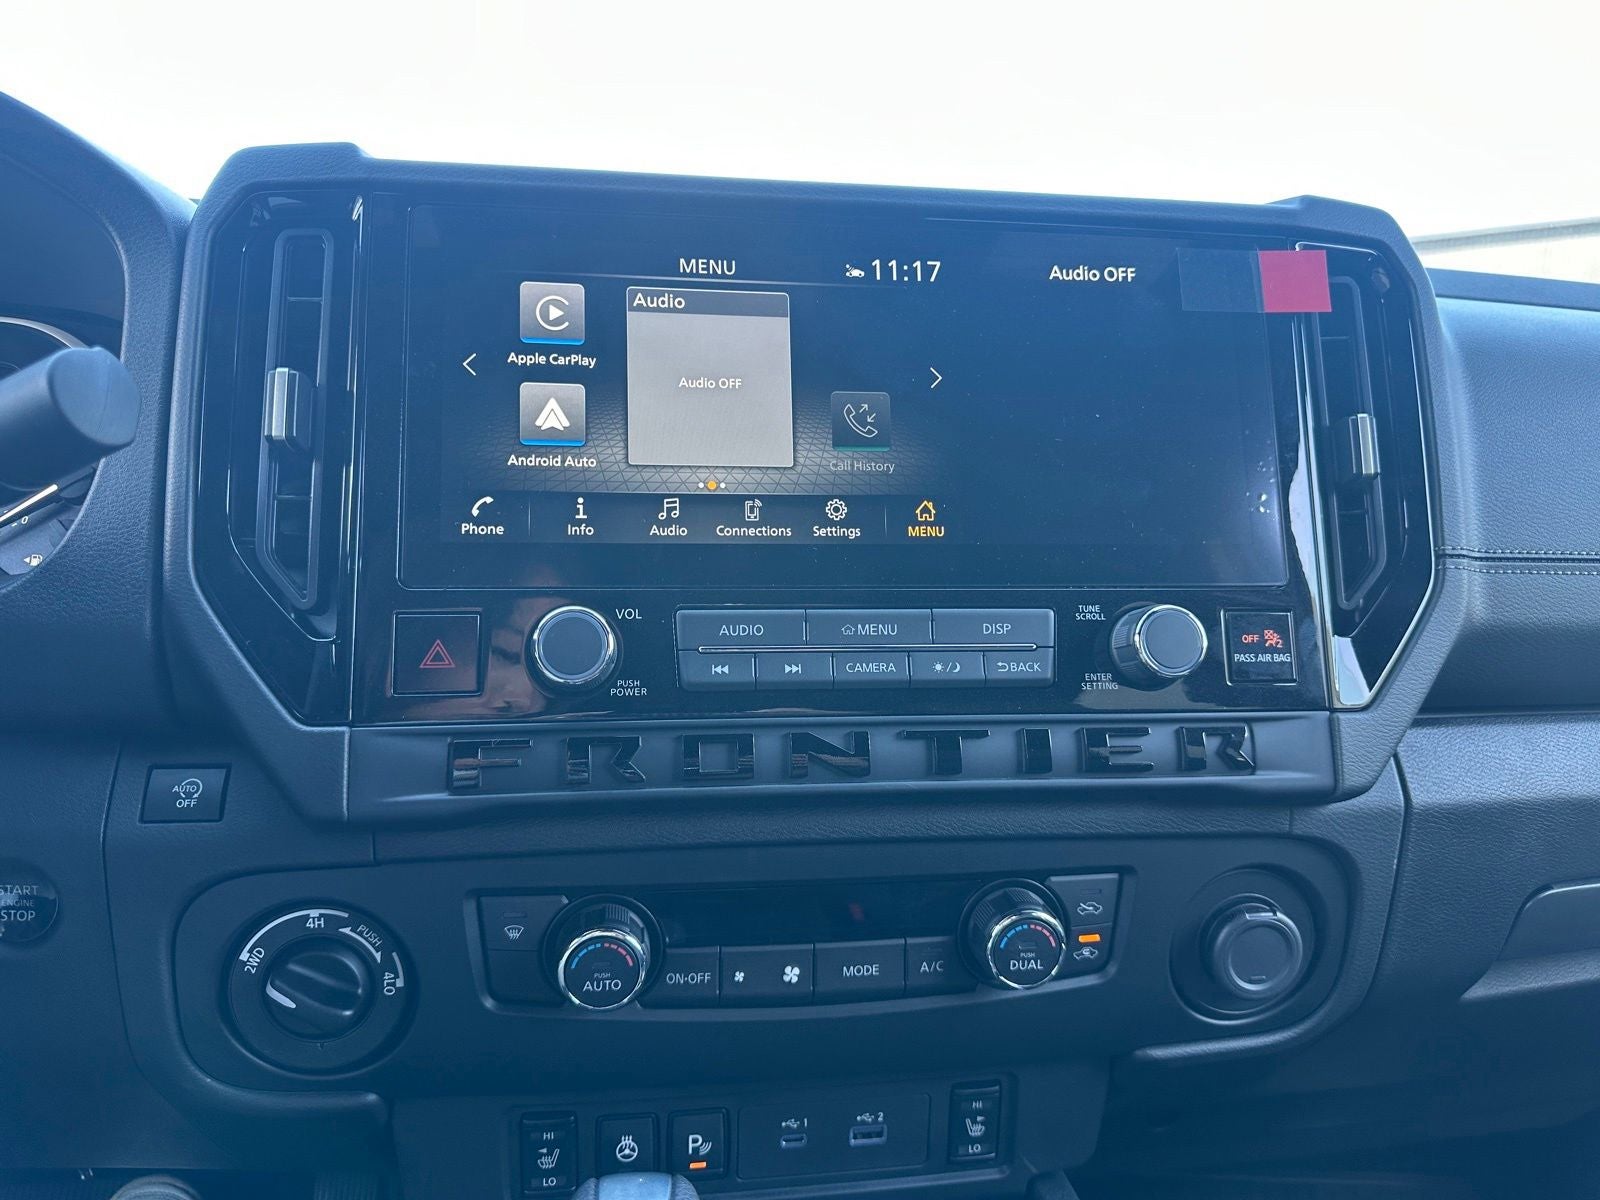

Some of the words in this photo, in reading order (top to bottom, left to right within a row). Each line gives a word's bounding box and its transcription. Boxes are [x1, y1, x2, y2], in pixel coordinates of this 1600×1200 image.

[679, 258, 736, 275] MENU
[871, 258, 941, 282] 11:17
[1049, 264, 1100, 281] Audio
[1104, 266, 1136, 282] OFF
[633, 292, 686, 309] Audio
[507, 352, 546, 367] Apple
[549, 353, 597, 369] CarPlay
[678, 377, 716, 389] Audio
[719, 378, 742, 389] OFF
[507, 454, 561, 467] Android
[564, 456, 597, 468] Auto
[829, 460, 851, 472] Call
[853, 460, 896, 474] History
[461, 523, 505, 535] Phone
[567, 524, 595, 536] Info
[650, 524, 688, 537] Audio
[716, 525, 792, 537] Connections
[813, 525, 861, 539] Settings
[908, 525, 945, 537] MENU
[615, 608, 643, 620] VOL
[1078, 605, 1101, 613] TUNE
[1075, 612, 1106, 621] SCROLL
[719, 624, 764, 637] AUDIO
[857, 623, 898, 636] MENU
[982, 623, 1012, 635] DISP
[1242, 634, 1260, 644] OFF
[1234, 653, 1256, 662] PASS
[1257, 653, 1272, 662] AIR
[1274, 653, 1291, 663] BAG
[846, 662, 897, 674] CAMERA
[1010, 662, 1042, 673] BACK
[617, 679, 640, 688] PUSH
[1085, 673, 1112, 682] ENTER
[610, 687, 648, 697] POWER
[1081, 682, 1119, 691] SETTING
[448, 724, 1256, 793] FRONTIER
[172, 784, 198, 794] AUTO
[176, 798, 198, 809] OFF
[0, 885, 39, 896] START
[0, 910, 36, 921] STOP
[306, 917, 325, 929] 4H
[356, 924, 383, 948] PUSH
[244, 947, 266, 974] 2WD
[1020, 951, 1036, 959] PUSH
[842, 964, 880, 977] MODE
[919, 960, 945, 974] A/C
[1010, 959, 1044, 972] DUAL
[594, 971, 611, 979] PUSH
[383, 971, 395, 995] 4LO
[582, 979, 622, 992] AUTO
[972, 1100, 983, 1110] HI
[877, 1112, 884, 1122] 2
[543, 1131, 554, 1141] HI
[968, 1143, 982, 1154] LO
[543, 1176, 557, 1187] LO
